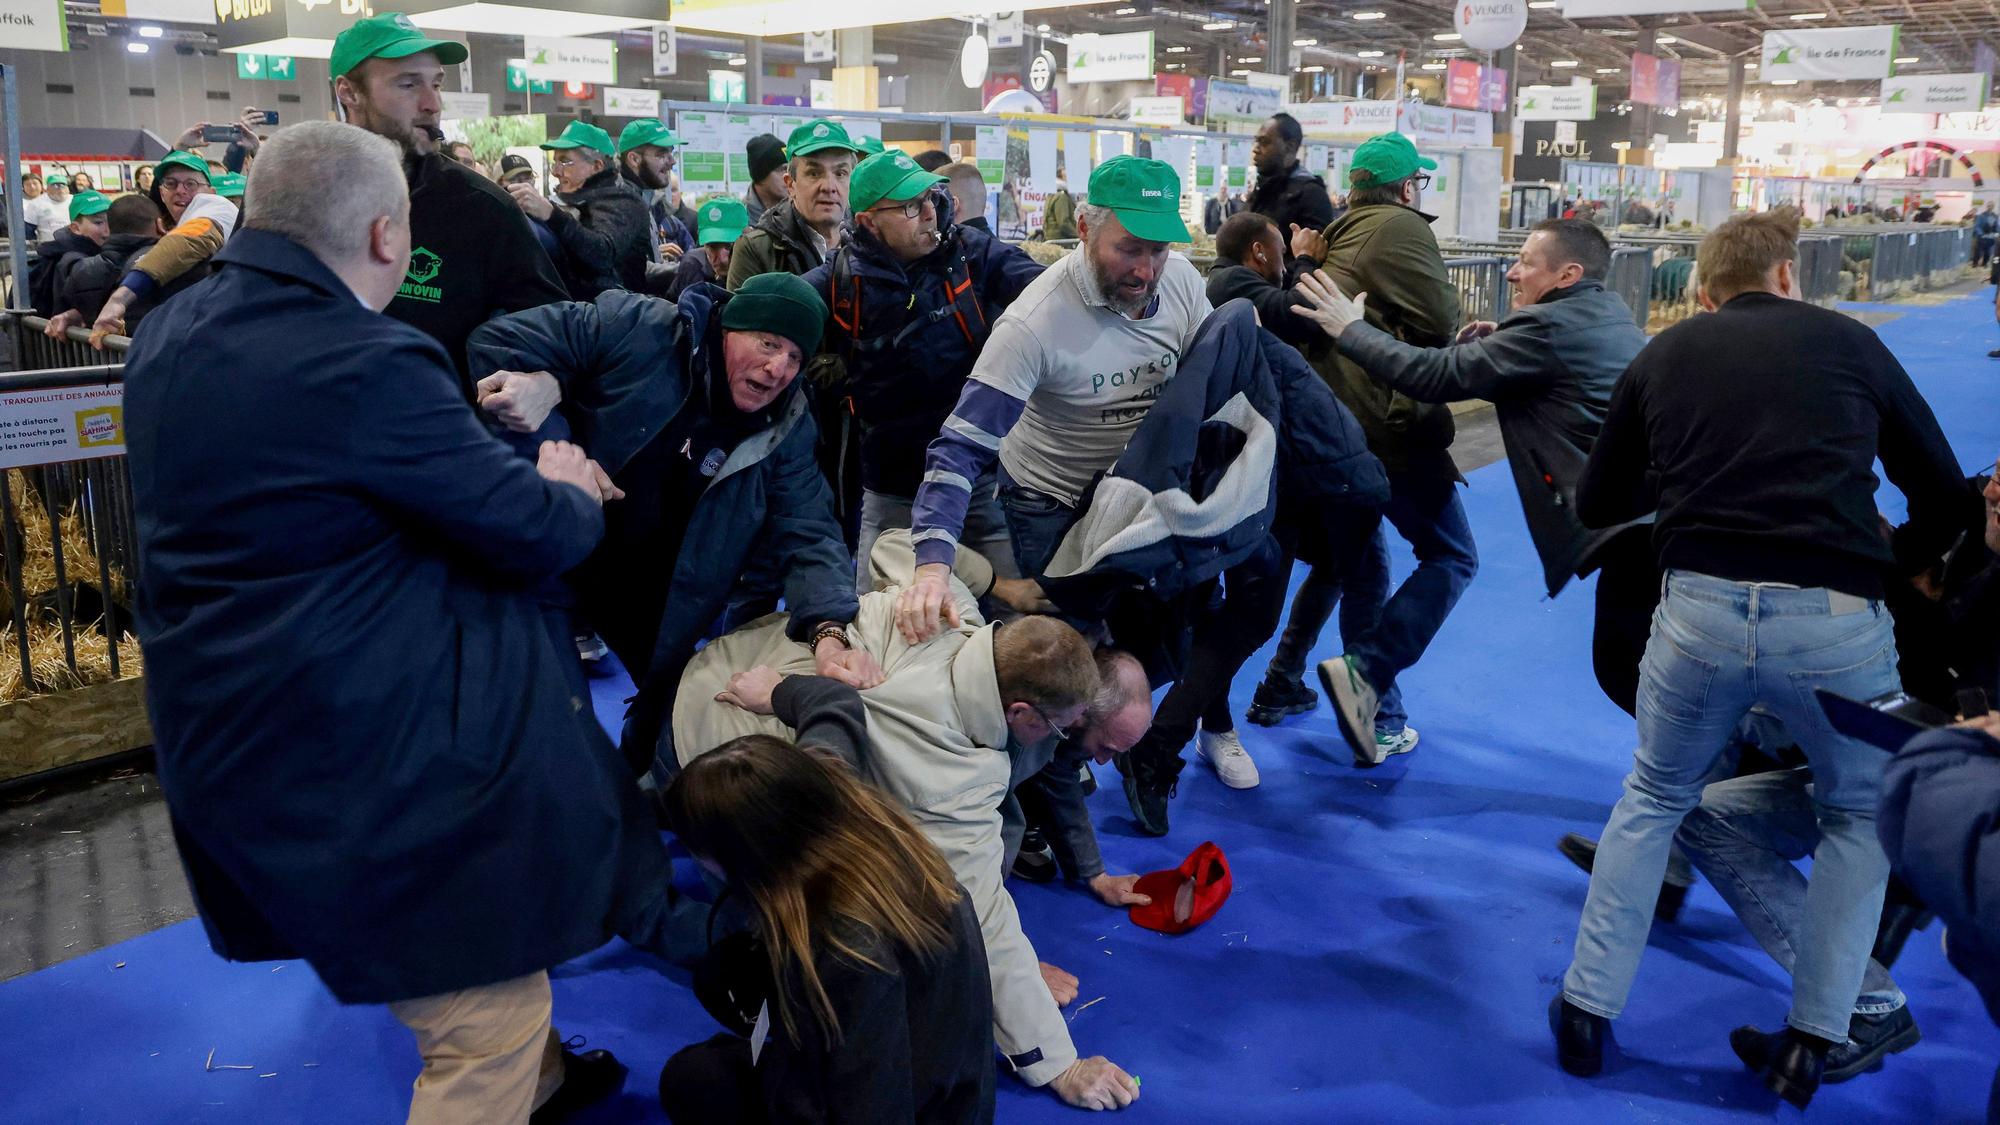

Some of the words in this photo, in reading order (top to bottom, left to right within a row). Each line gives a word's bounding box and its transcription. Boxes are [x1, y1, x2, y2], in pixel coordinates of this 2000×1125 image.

[0, 13, 34, 26] ffolk
[658, 30, 670, 54] B
[1119, 51, 1146, 61] France
[1807, 47, 1820, 58] Île
[1825, 47, 1839, 57] de
[1843, 46, 1886, 58] France
[582, 55, 609, 65] France
[1536, 139, 1592, 157] PAUL
[3, 391, 63, 406] TRANQUILLITÉ
[66, 392, 82, 400] DES
[84, 389, 122, 399] ANIMAUX
[22, 417, 58, 426] distance
[18, 428, 47, 437] touche
[50, 428, 65, 436] pas
[20, 439, 50, 449] nourris
[52, 439, 67, 447] pas
